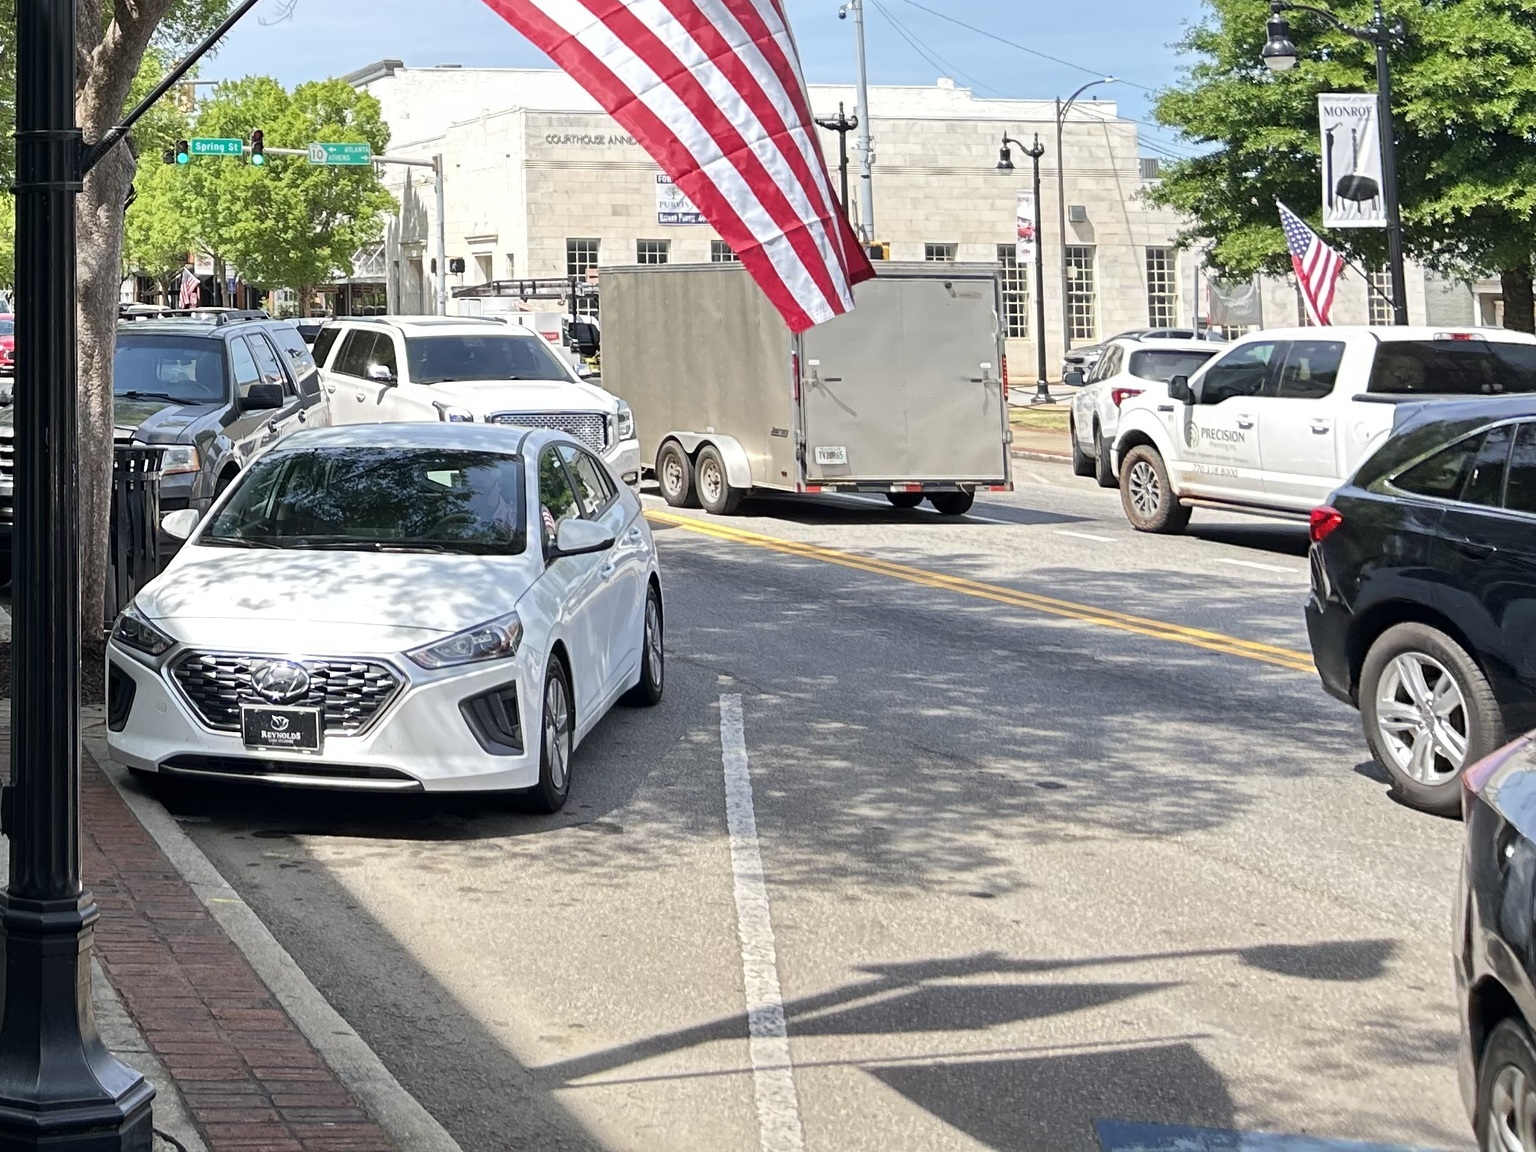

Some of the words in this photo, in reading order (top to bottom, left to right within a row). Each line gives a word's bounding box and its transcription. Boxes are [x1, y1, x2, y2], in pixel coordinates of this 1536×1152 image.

[545, 134, 605, 145] COURTHOUSE
[608, 134, 640, 146] ANNE
[195, 141, 225, 153] Spring
[228, 142, 239, 152] St
[311, 149, 324, 160] 10
[1201, 427, 1246, 443] PRECISION
[261, 730, 301, 740] REYNOLDS
